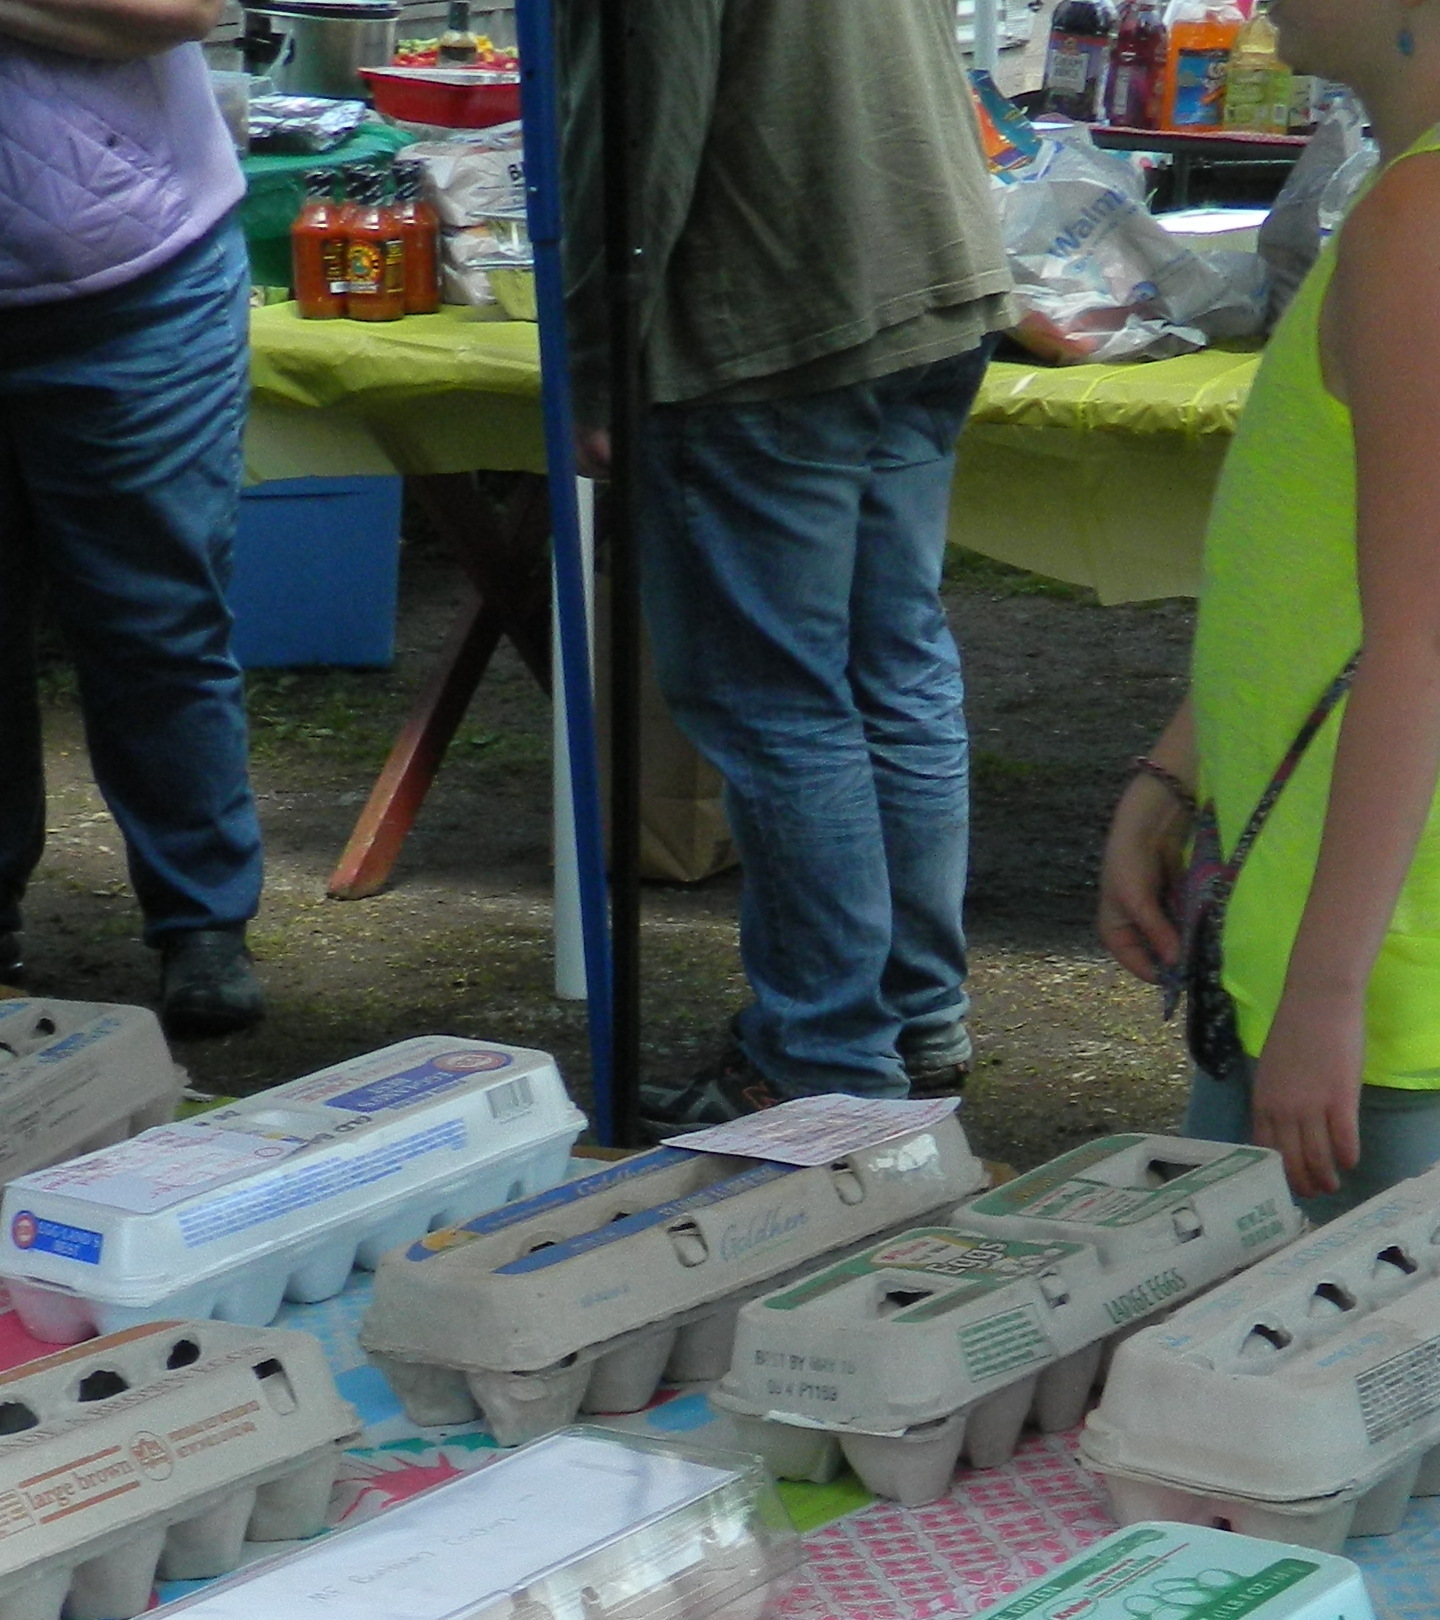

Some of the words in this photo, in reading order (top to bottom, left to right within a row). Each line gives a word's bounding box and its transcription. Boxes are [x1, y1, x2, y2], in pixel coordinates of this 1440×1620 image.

[19, 1475, 75, 1511] large
[73, 1458, 136, 1493] brown
[1013, 1586, 1062, 1618] DOZEN
